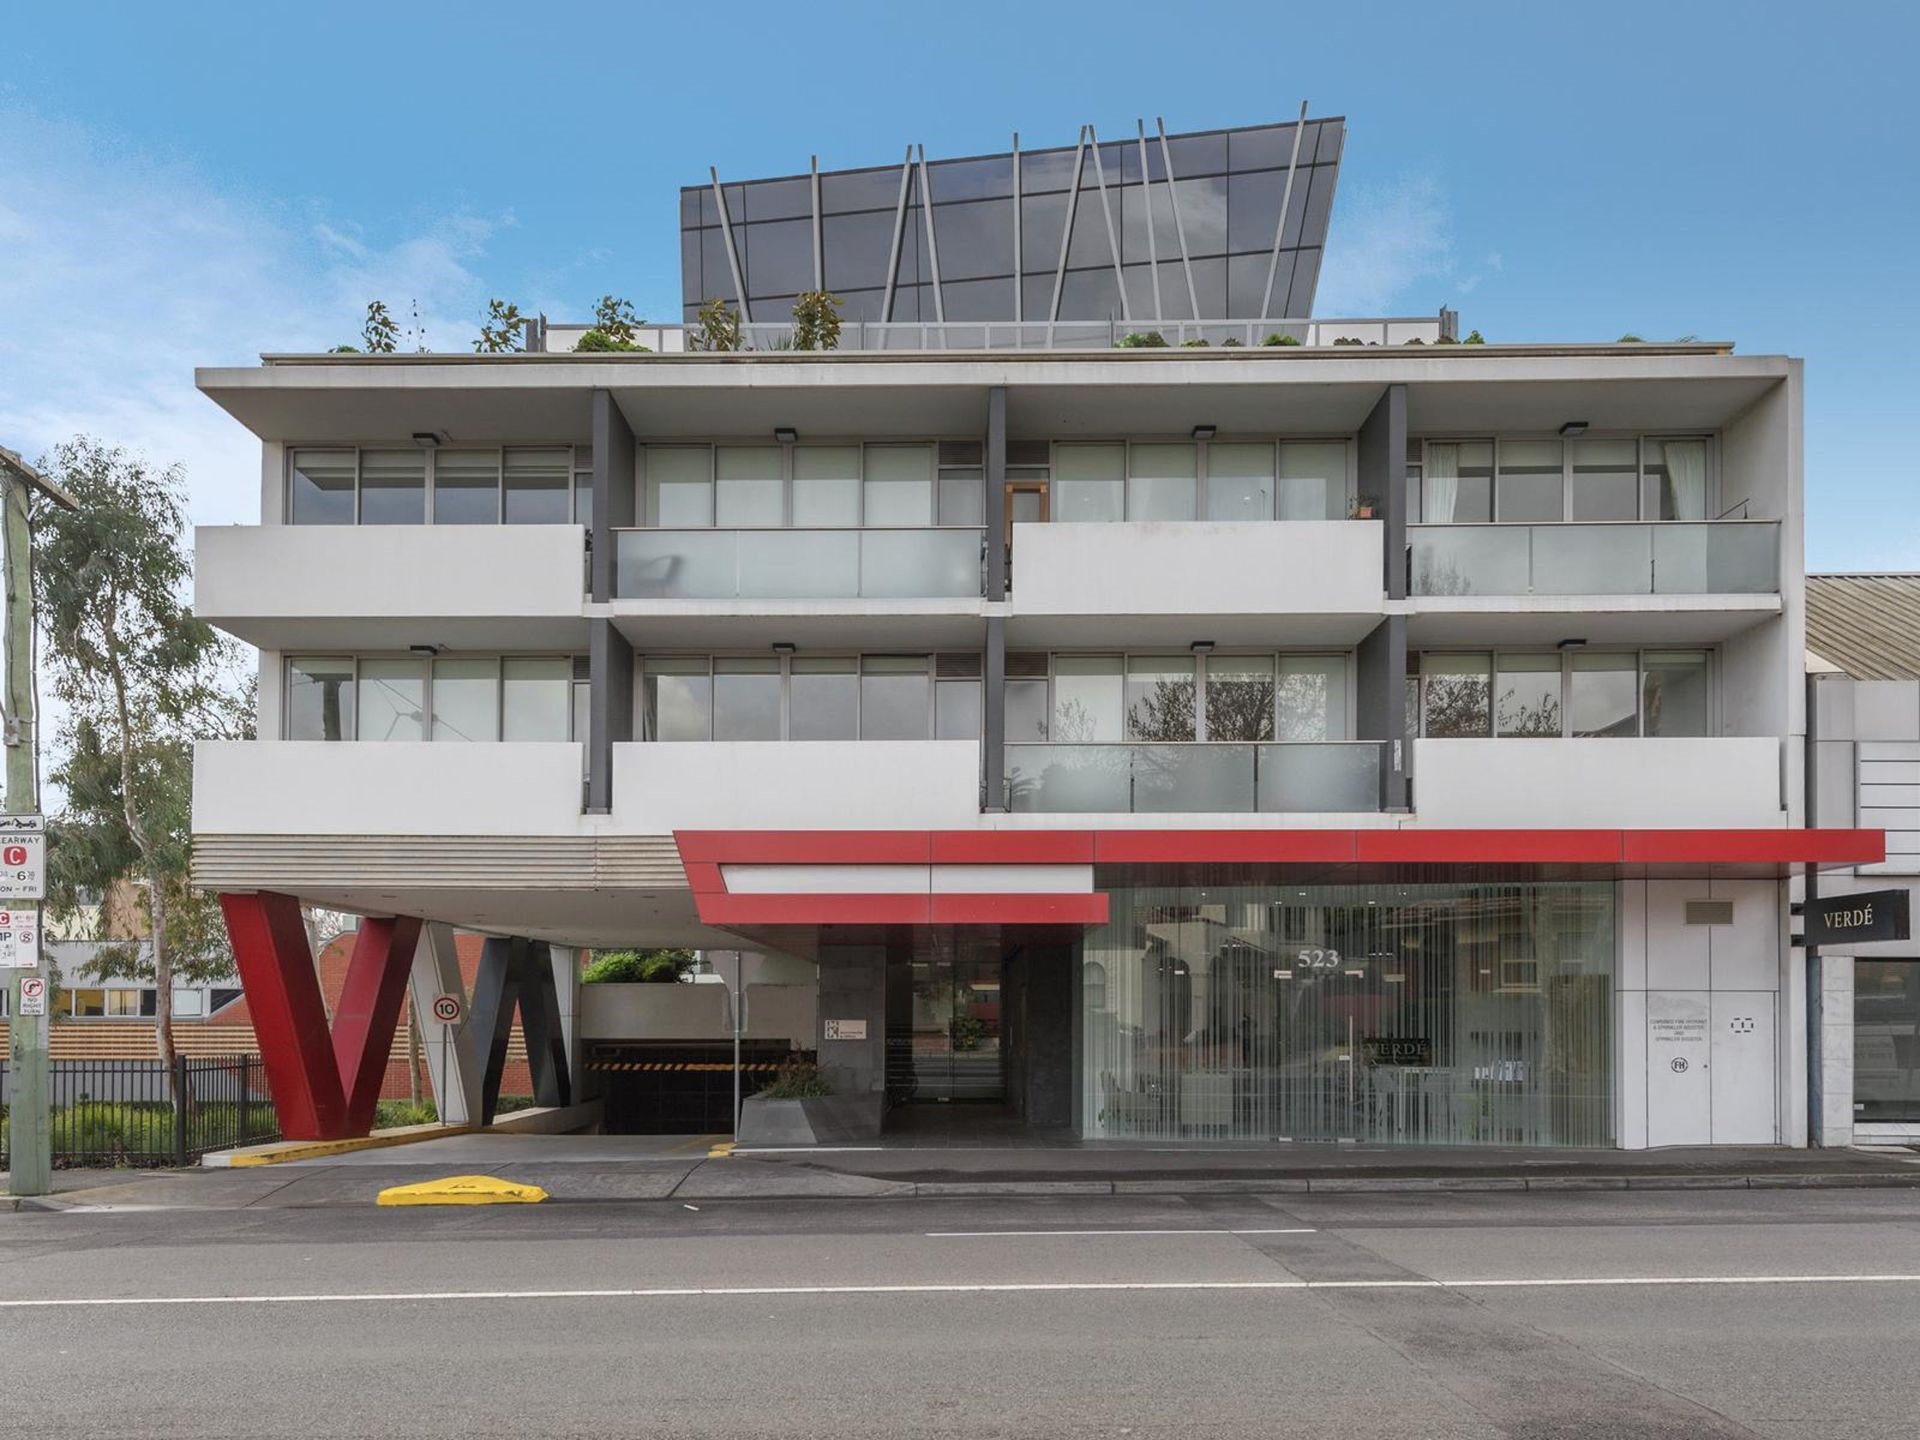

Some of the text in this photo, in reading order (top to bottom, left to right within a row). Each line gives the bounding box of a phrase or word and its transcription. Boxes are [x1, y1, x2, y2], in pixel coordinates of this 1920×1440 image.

[0, 836, 41, 844] EARWAY
[9, 847, 21, 865] C
[0, 885, 13, 893] ON
[1824, 903, 1873, 928] VERDÉ
[1297, 949, 1339, 968] 523
[440, 1003, 455, 1015] 10
[1674, 1060, 1685, 1069] FH
